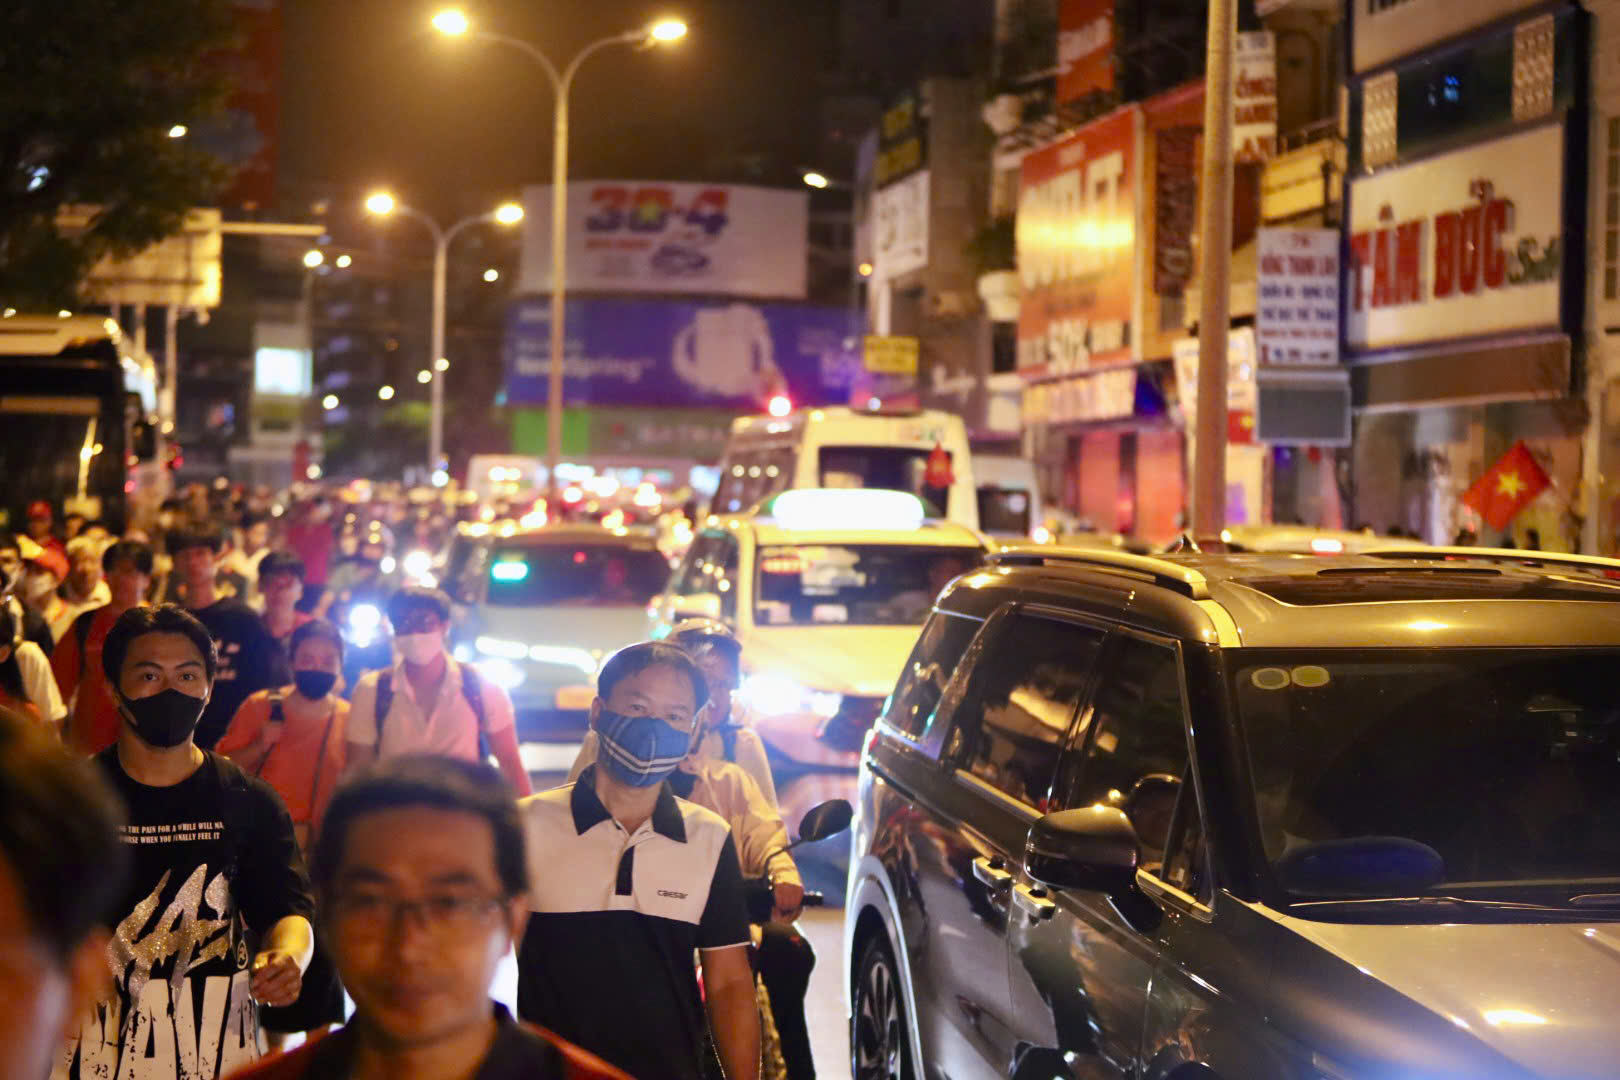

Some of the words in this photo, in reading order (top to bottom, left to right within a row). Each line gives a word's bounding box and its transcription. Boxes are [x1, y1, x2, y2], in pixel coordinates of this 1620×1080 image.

[158, 825, 170, 833] FOR
[198, 822, 213, 830] WILL
[214, 821, 224, 830] MA
[140, 835, 158, 844] WHEN
[160, 835, 172, 843] YOU
[198, 832, 212, 840] FEEL
[213, 832, 221, 840] IT
